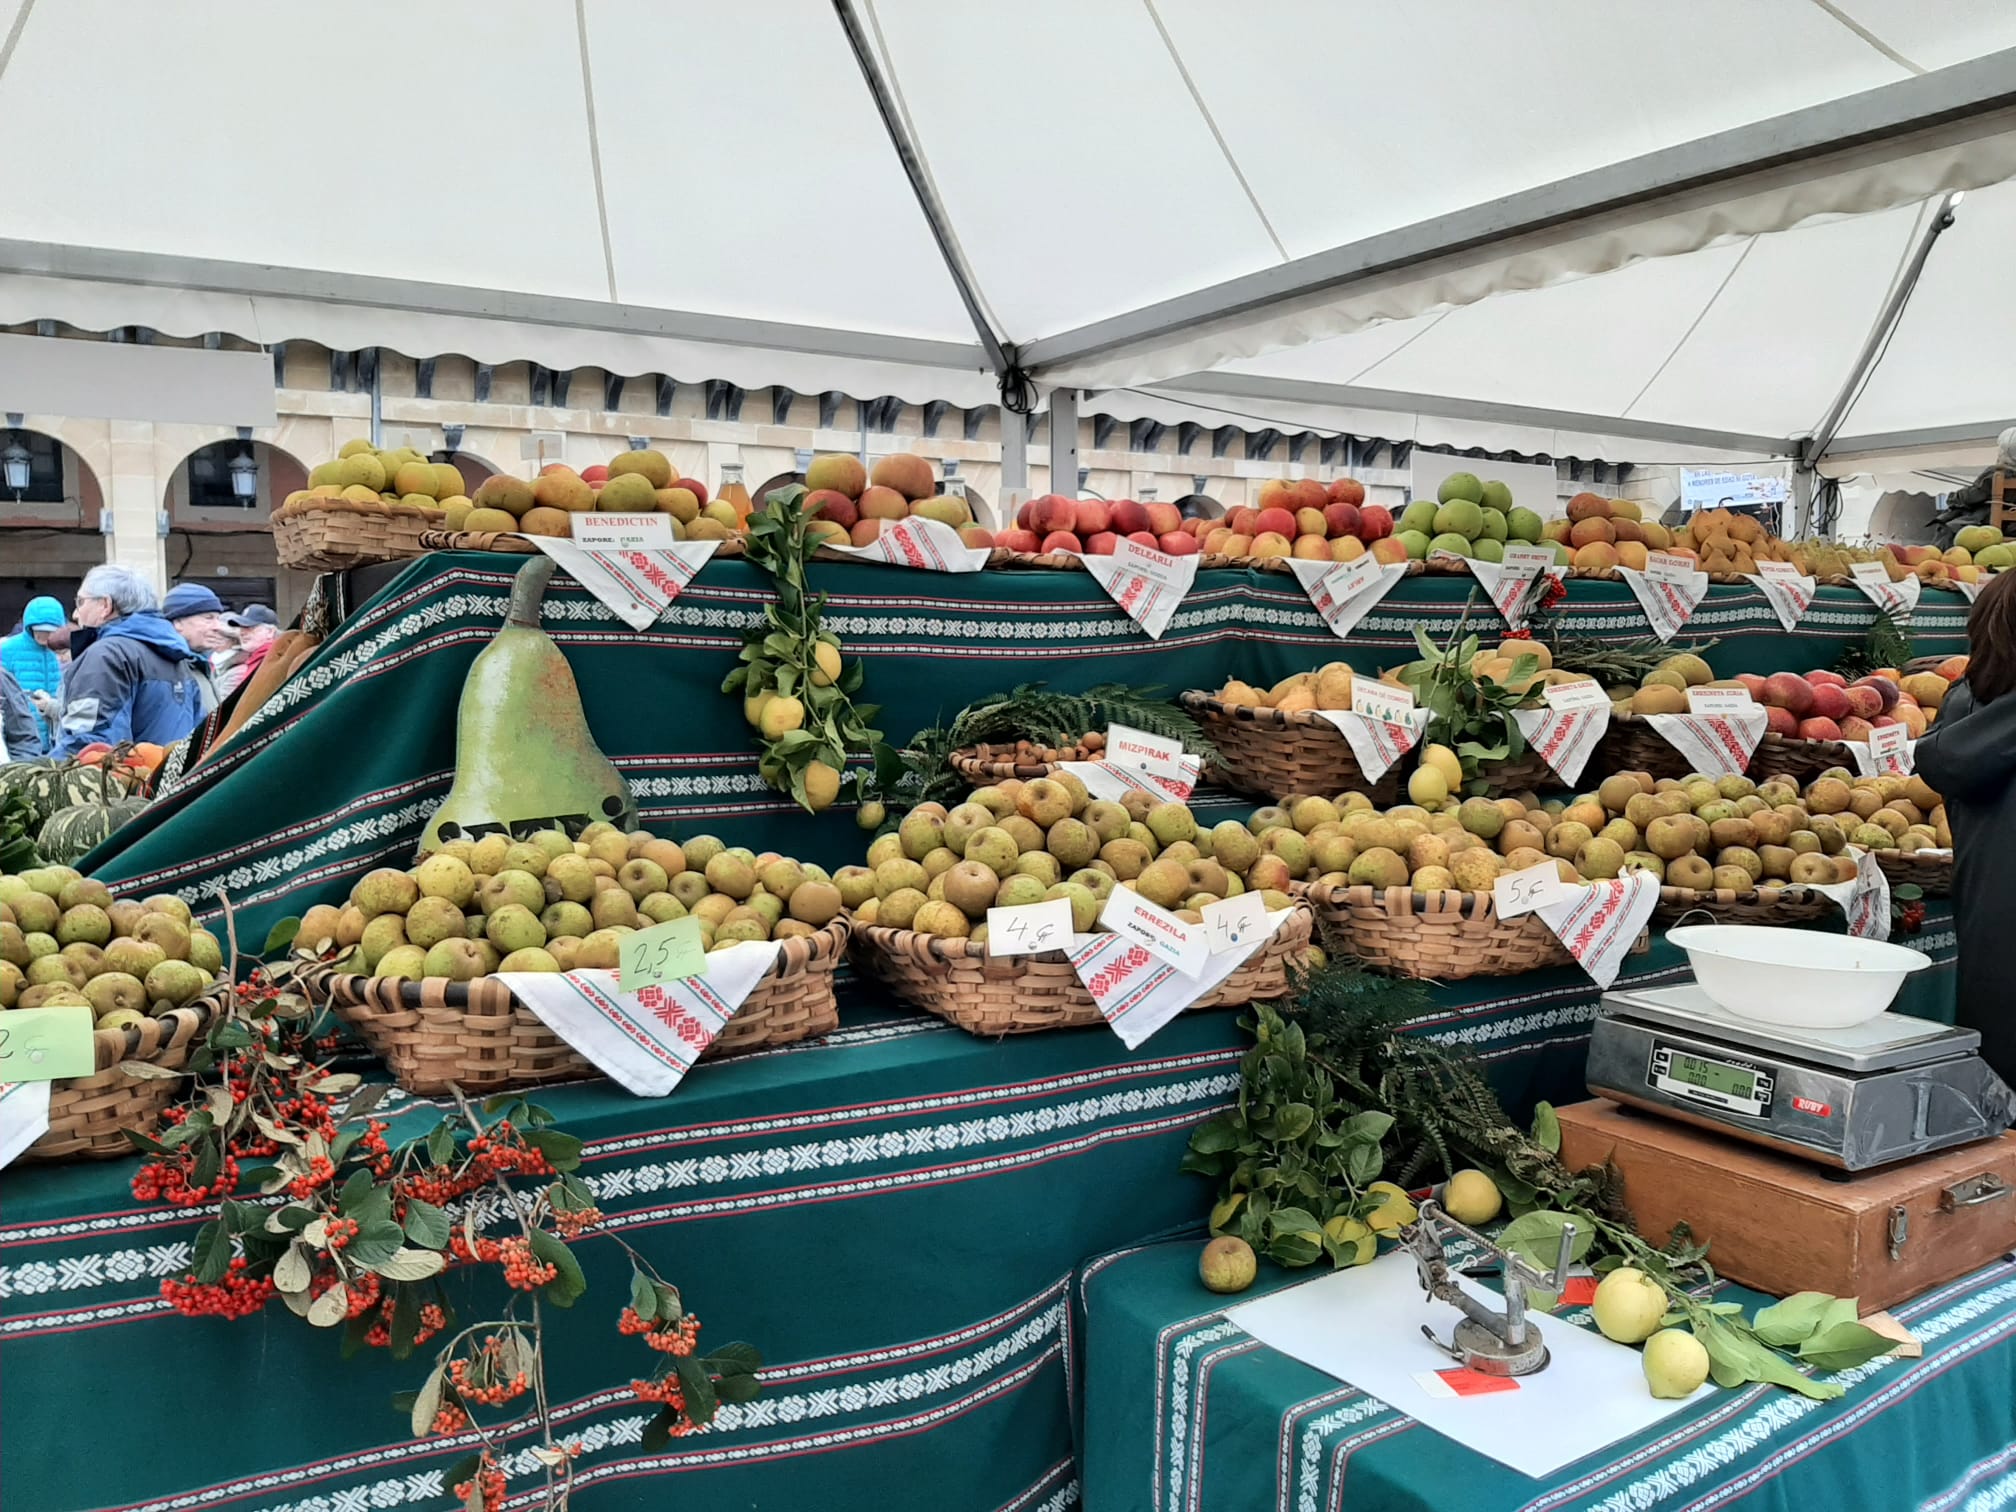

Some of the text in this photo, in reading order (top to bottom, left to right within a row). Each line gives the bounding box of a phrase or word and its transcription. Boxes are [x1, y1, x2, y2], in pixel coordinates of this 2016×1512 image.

[585, 517, 658, 527] BENEDICTIN
[1118, 740, 1172, 762] MIZPIRAK
[1134, 905, 1187, 942] ERREZILA
